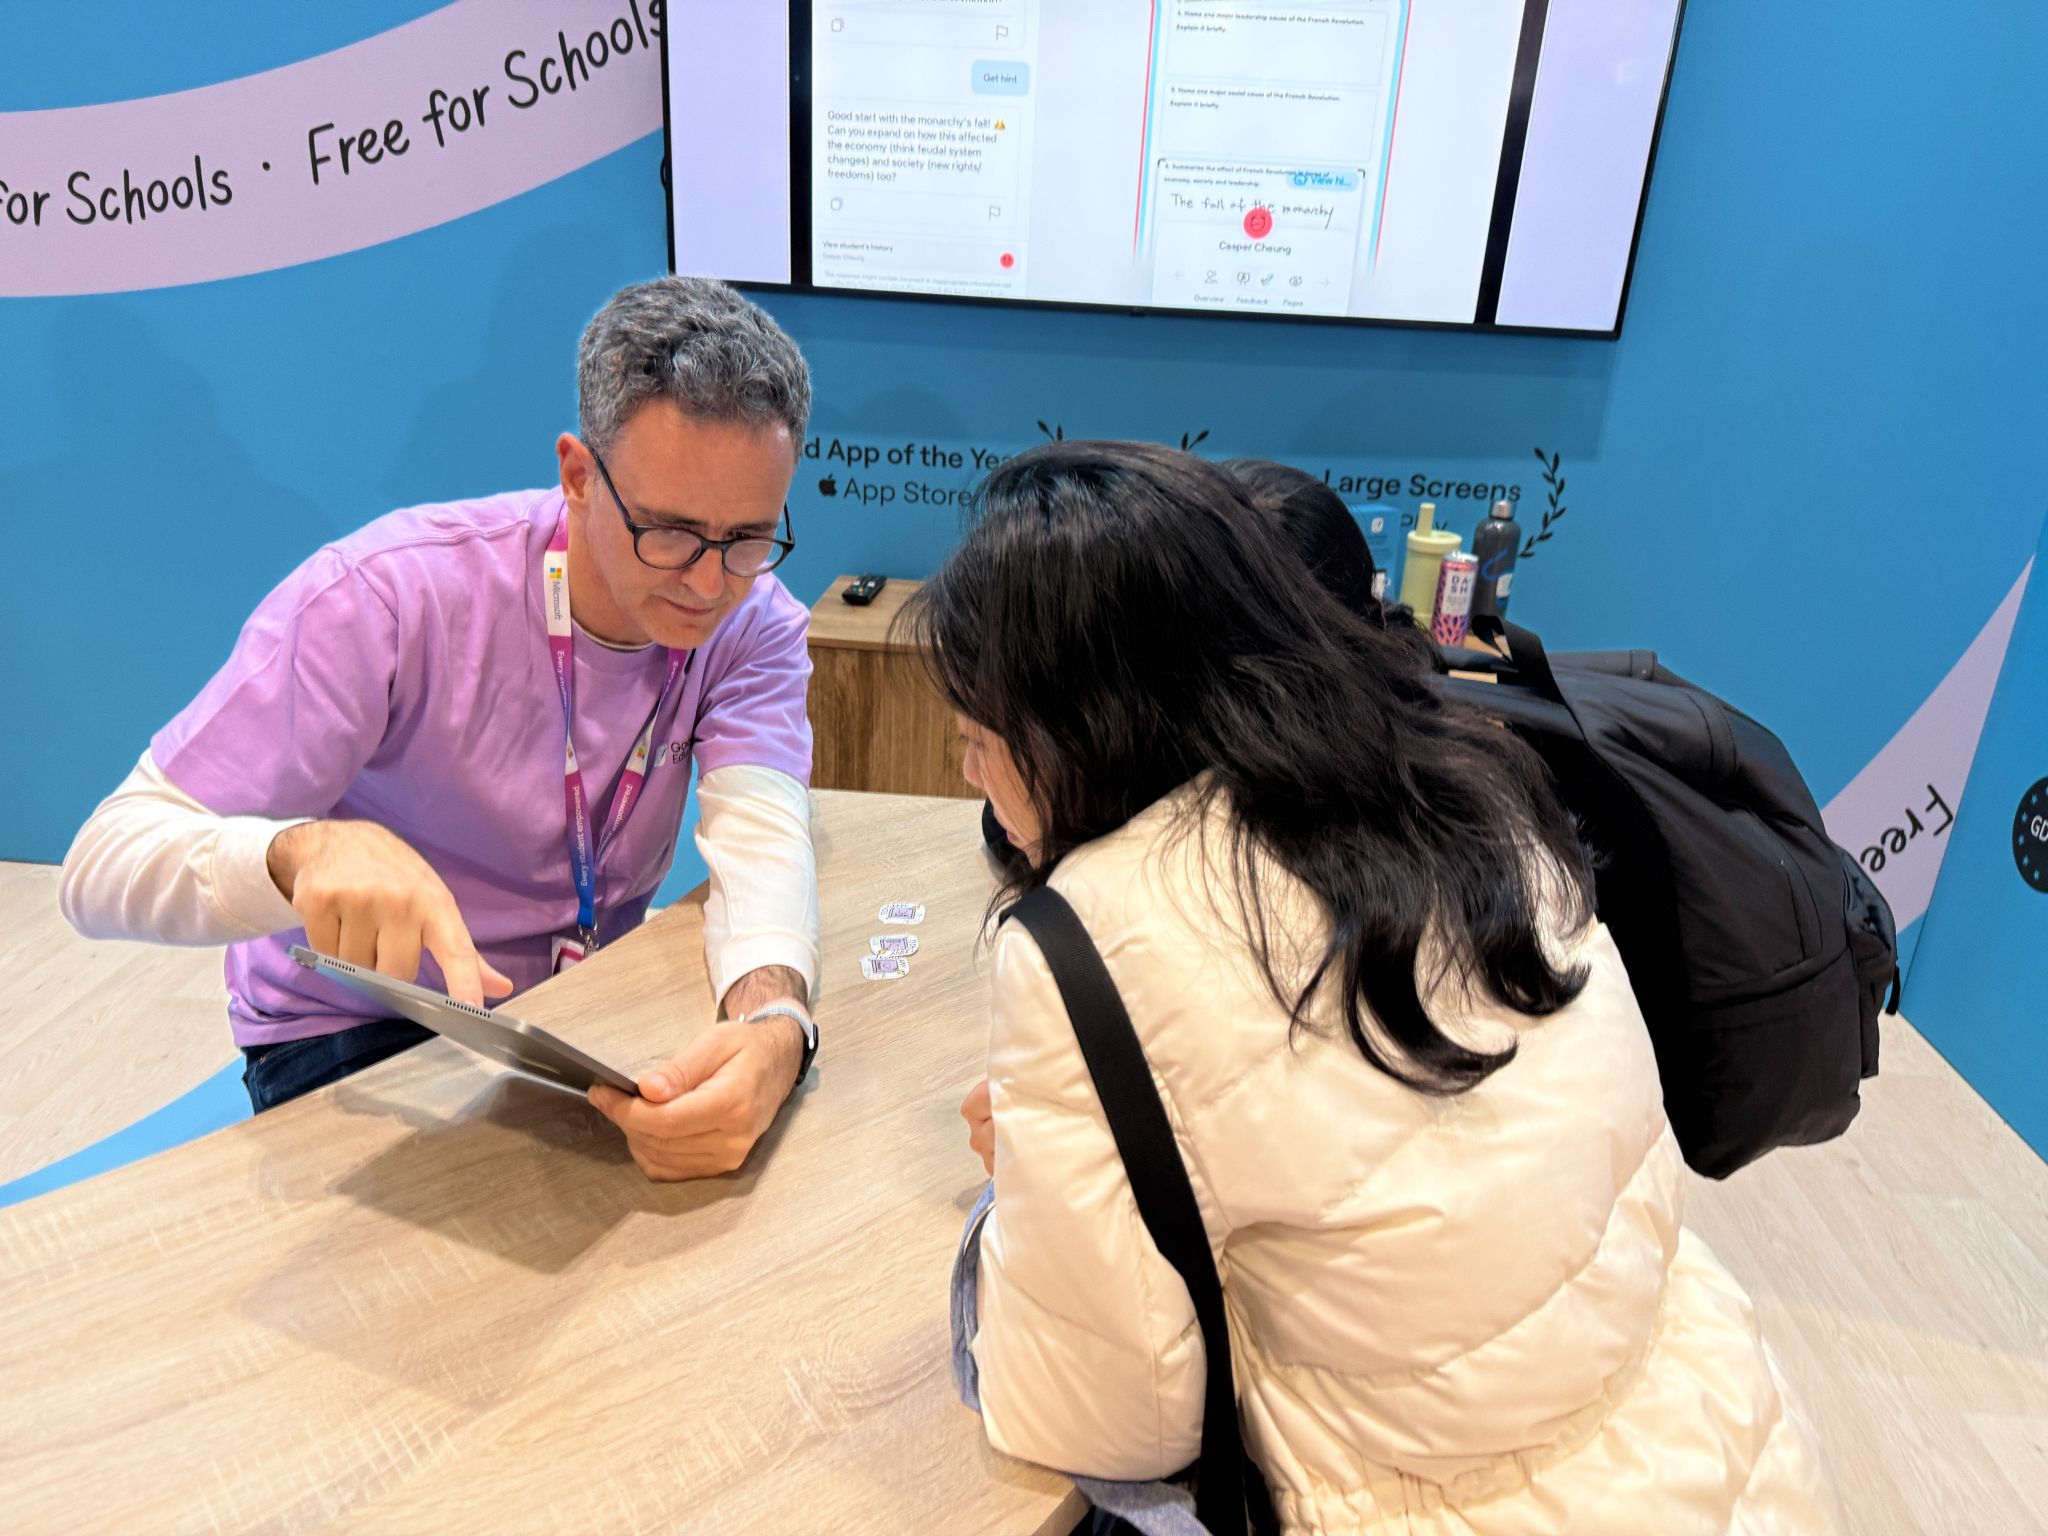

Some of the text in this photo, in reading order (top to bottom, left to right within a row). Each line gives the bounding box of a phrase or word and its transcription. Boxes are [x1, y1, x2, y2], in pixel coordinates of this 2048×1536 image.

[983, 73, 1018, 84] Get hint
[828, 110, 991, 128] Good start with the monarchy's fall!
[308, 119, 410, 186] Free
[422, 83, 490, 147] for
[828, 125, 997, 143] Can you expand on how this affected
[828, 140, 981, 157] the economy (think feudal system
[827, 154, 982, 174] changes) and society (new rights/
[827, 168, 897, 181] freedoms) too?
[0, 155, 233, 227] or Schools
[1170, 193, 1193, 209] The
[1201, 197, 1225, 210] fall
[1230, 197, 1246, 213] of
[1219, 240, 1292, 256] Casper Cheung
[827, 439, 880, 469] App
[887, 443, 914, 465] of
[920, 445, 963, 469] the
[844, 478, 972, 507] App Store
[1408, 473, 1522, 502] Screens
[551, 581, 562, 620] Microsoft
[1860, 783, 1954, 873] Free
